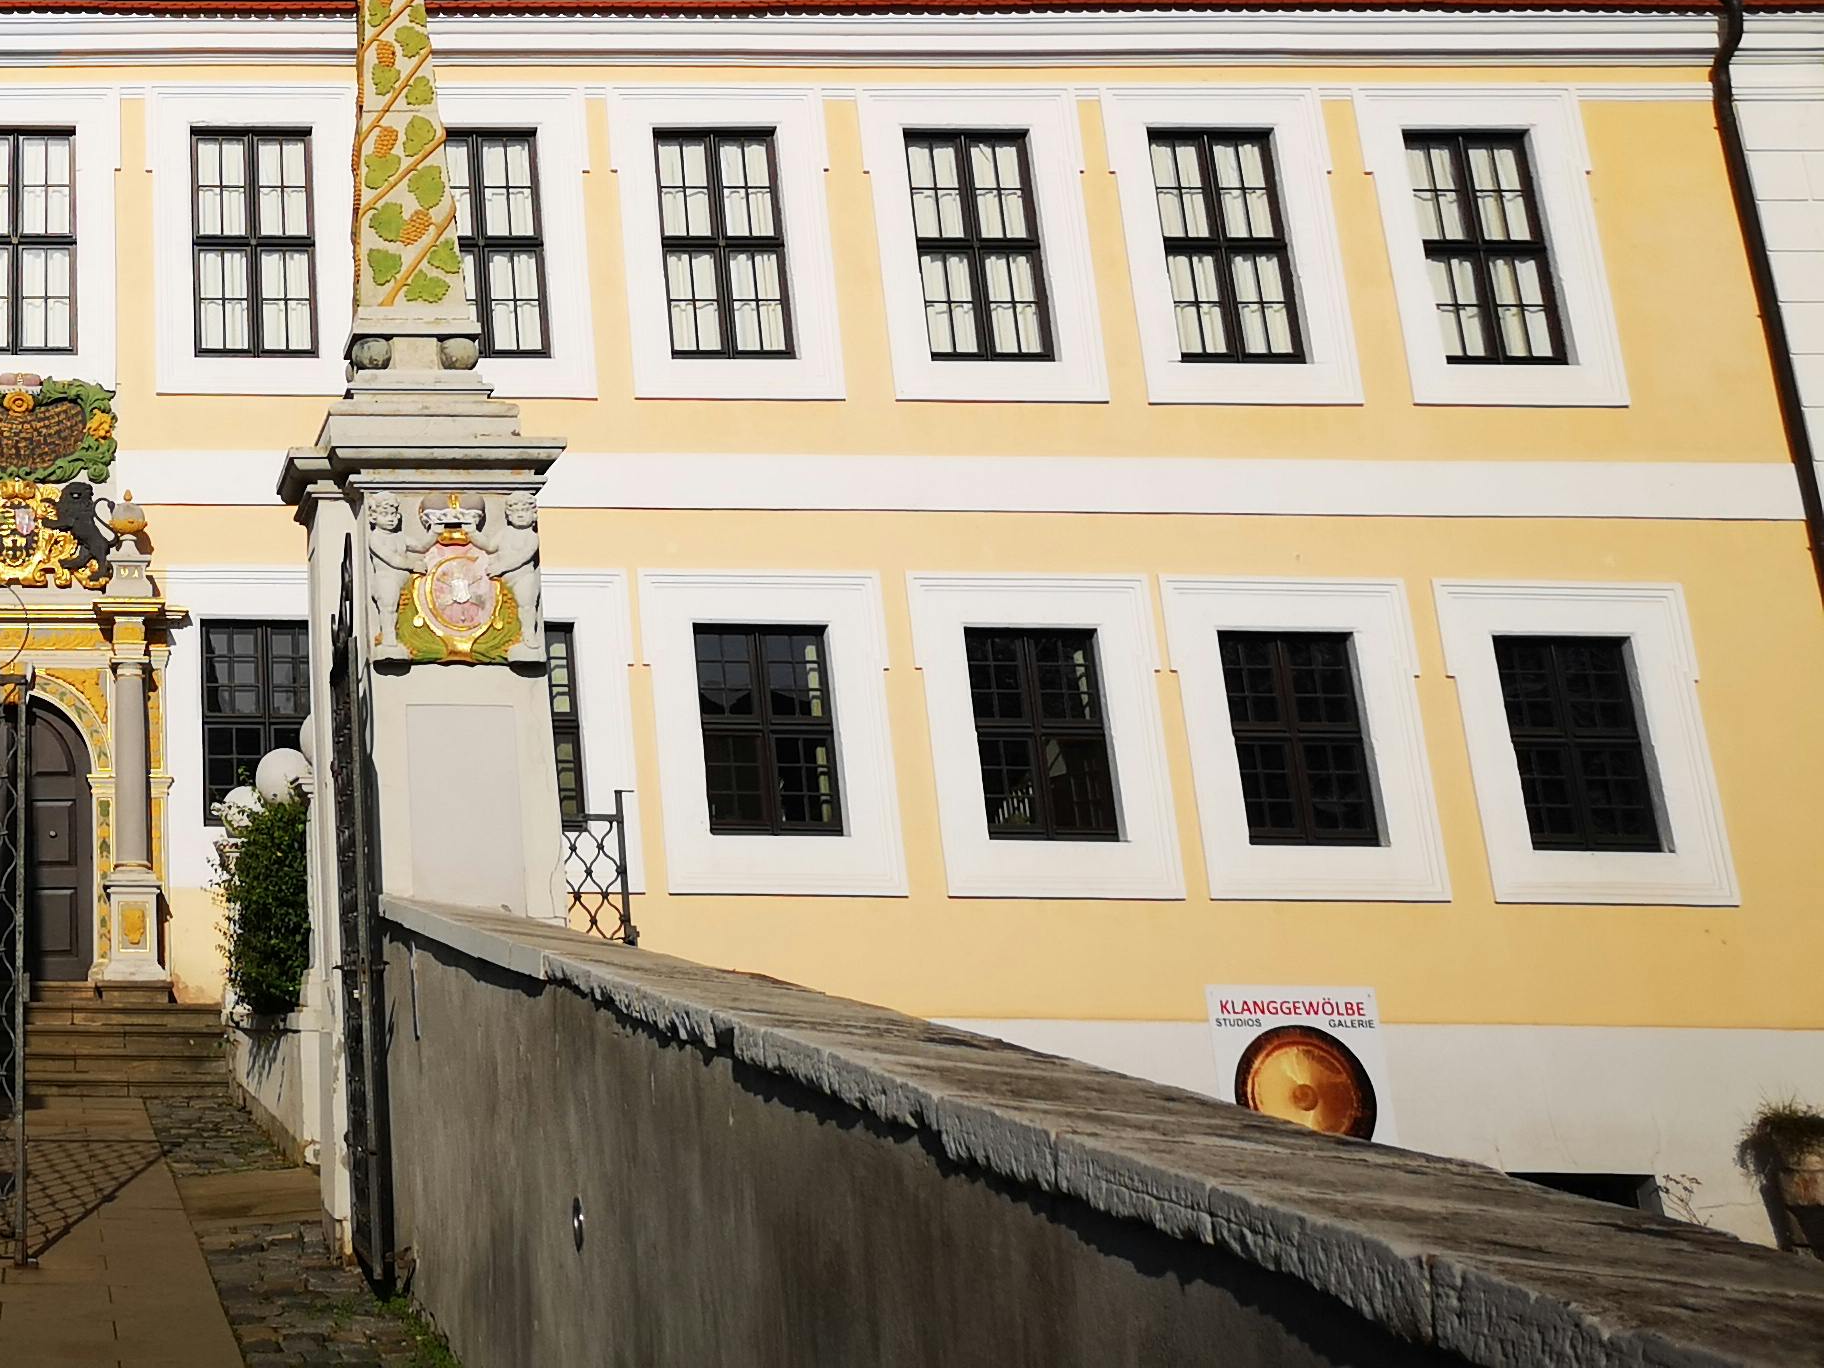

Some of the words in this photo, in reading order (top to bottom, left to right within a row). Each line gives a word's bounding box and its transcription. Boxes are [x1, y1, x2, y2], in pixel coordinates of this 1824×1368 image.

[1219, 997, 1366, 1016] KLANGGEWÖLBE
[1215, 1018, 1262, 1028] STUDIOS
[1328, 1019, 1376, 1029] GALERIE
